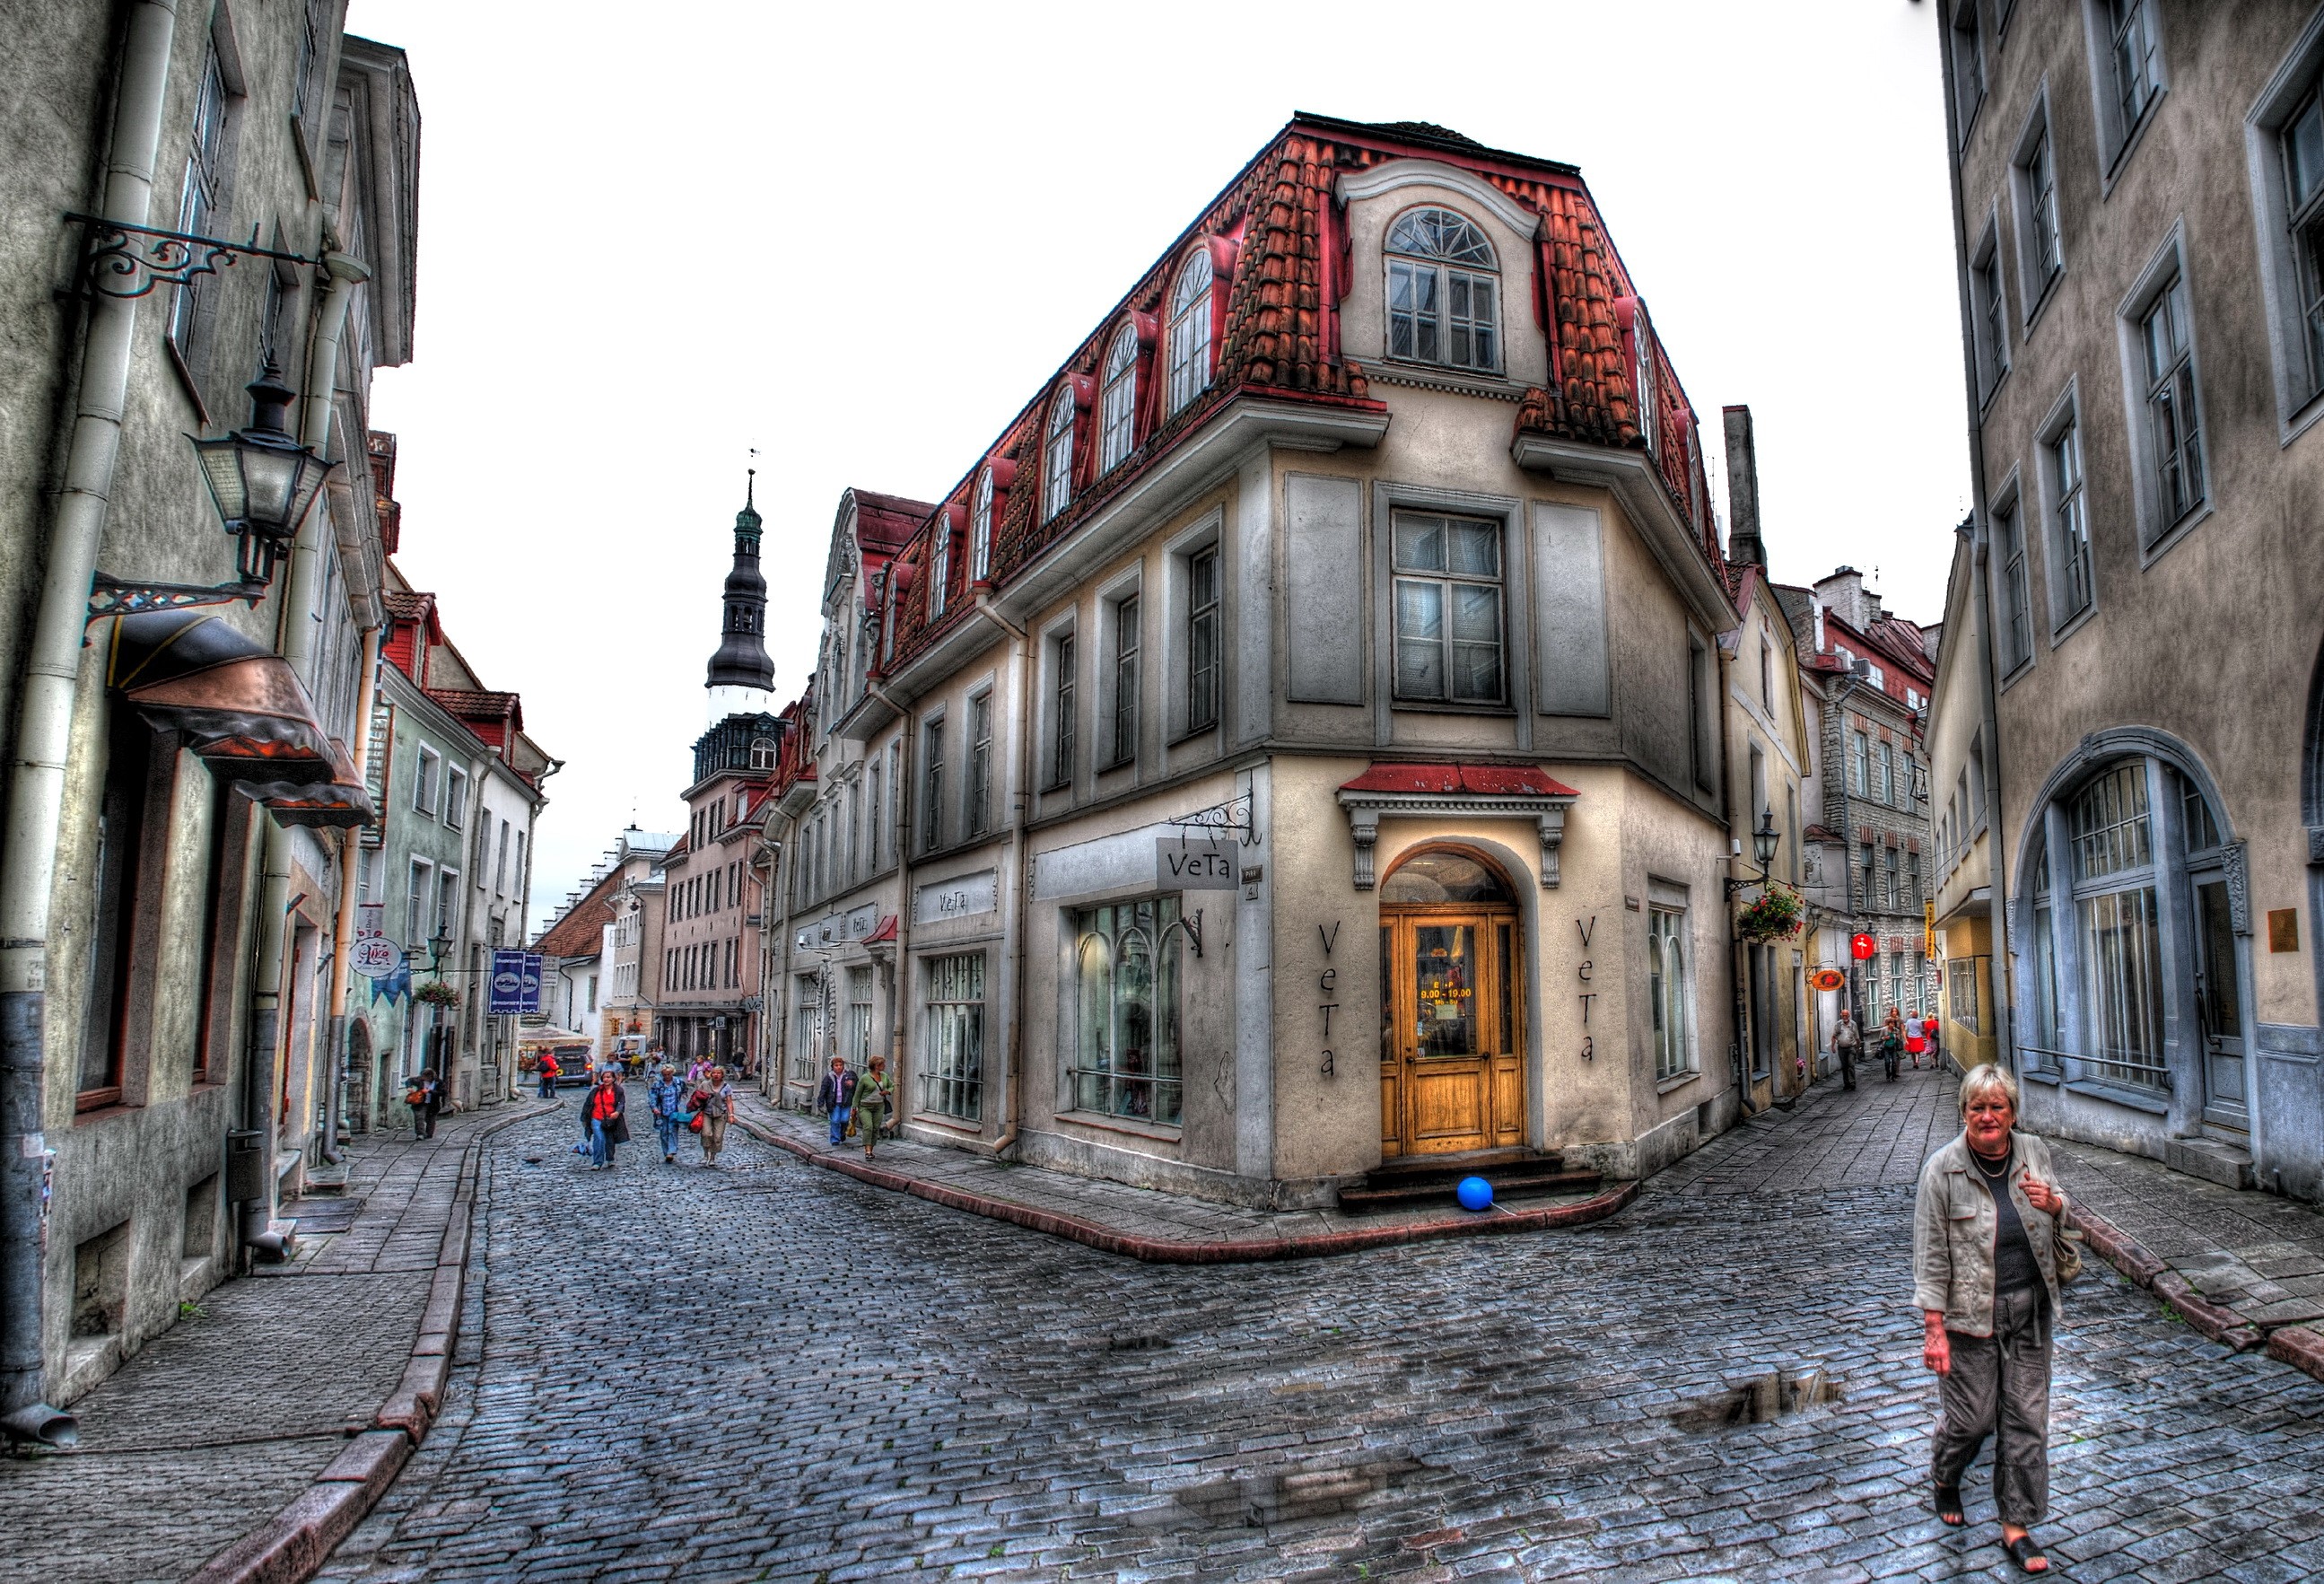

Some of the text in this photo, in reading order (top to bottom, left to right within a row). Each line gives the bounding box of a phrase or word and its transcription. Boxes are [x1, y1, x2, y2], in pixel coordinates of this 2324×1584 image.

[1167, 853, 1230, 879] VeTa
[939, 891, 967, 912] VeTa
[1318, 920, 1341, 1077] VeTa
[1420, 990, 1440, 999] 9.00
[1448, 988, 1472, 998] 19.00
[1575, 915, 1597, 1061] VeTa
